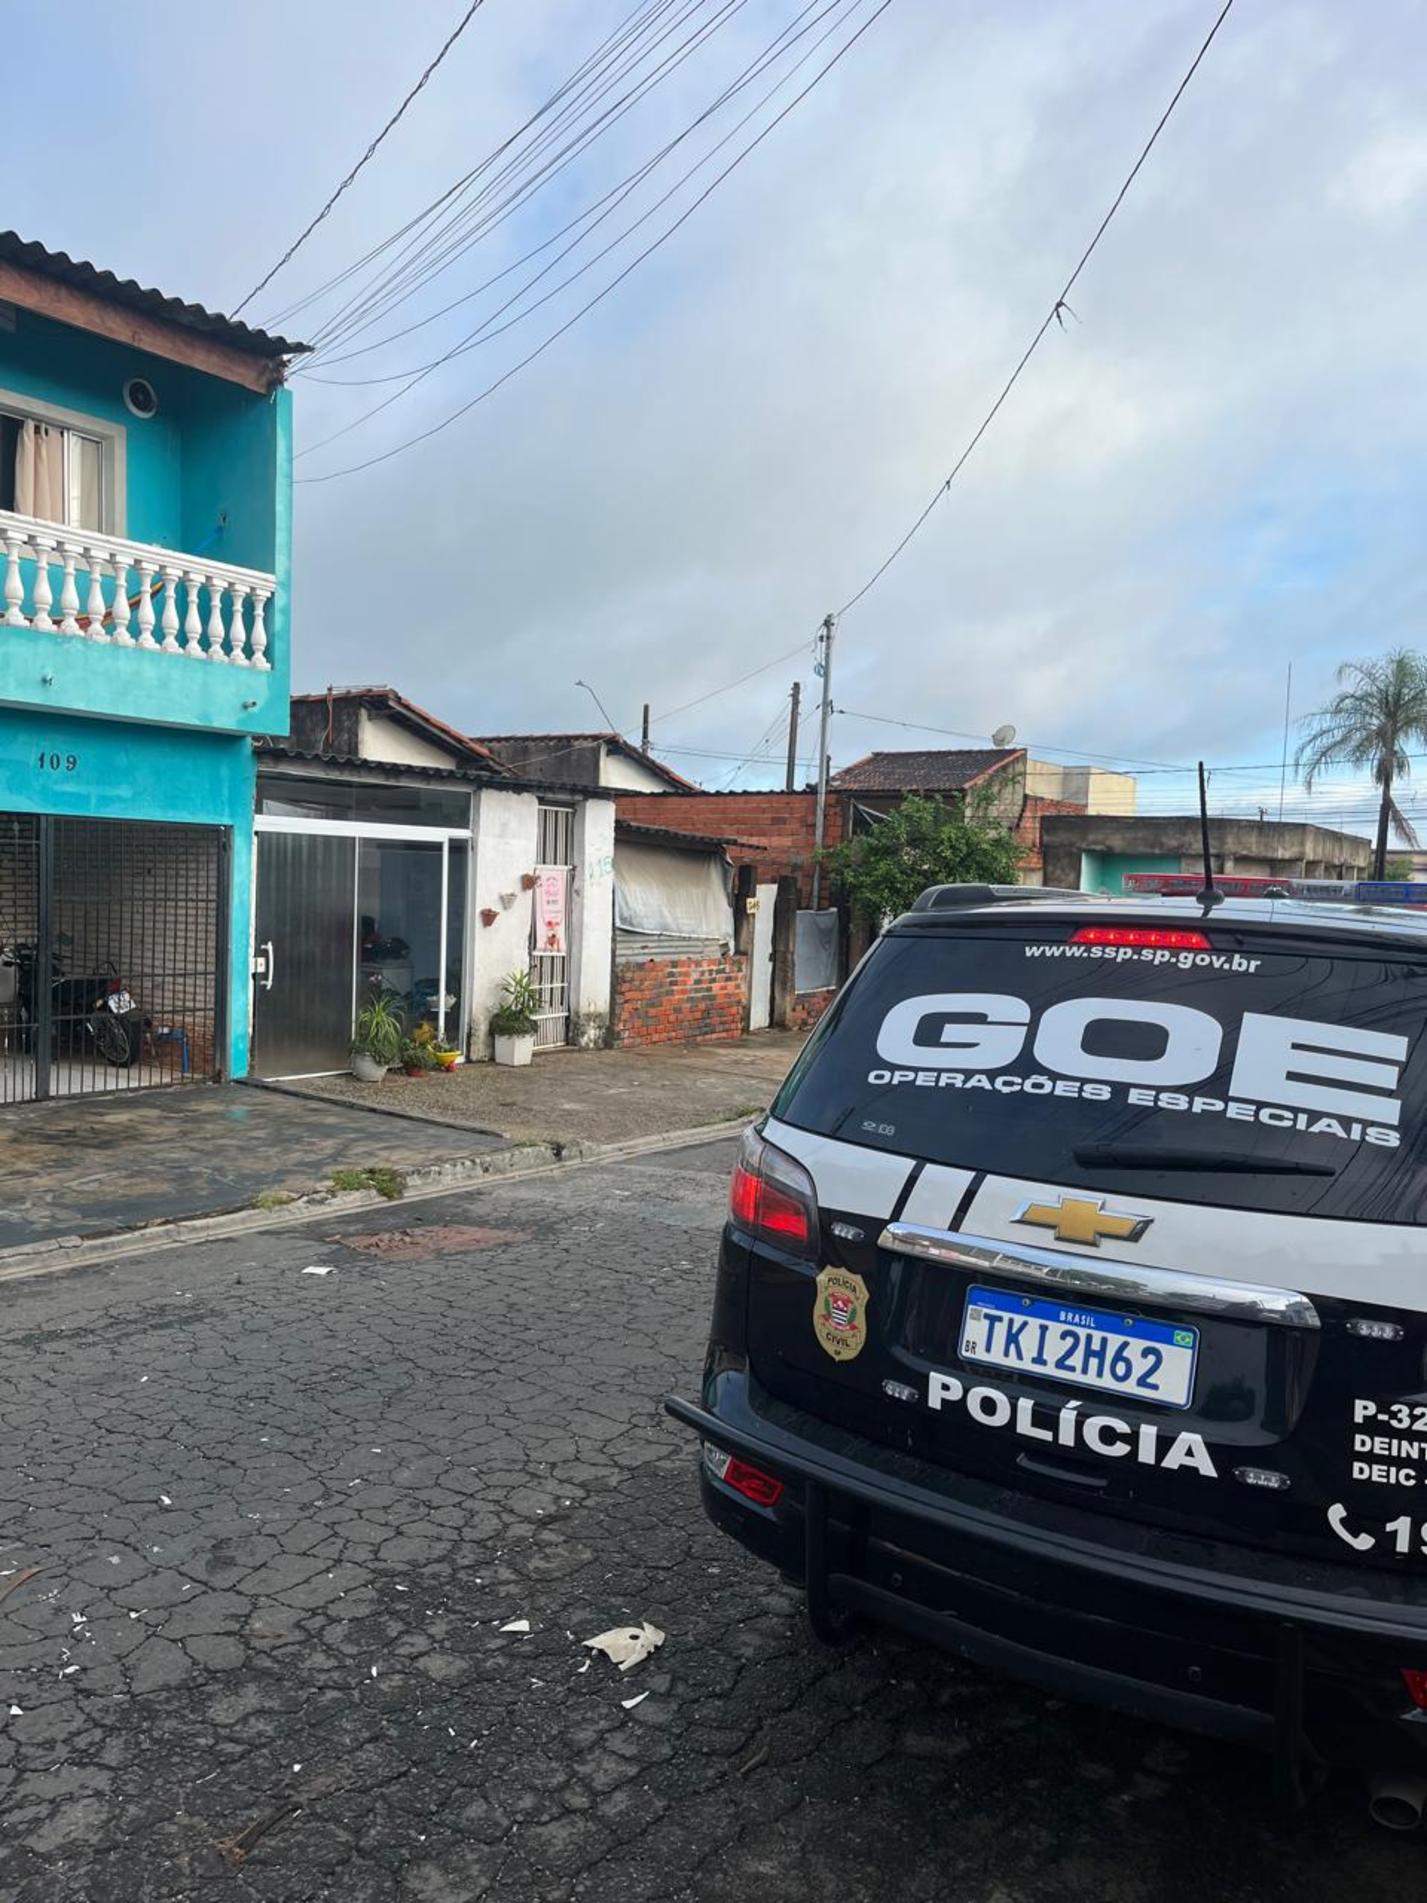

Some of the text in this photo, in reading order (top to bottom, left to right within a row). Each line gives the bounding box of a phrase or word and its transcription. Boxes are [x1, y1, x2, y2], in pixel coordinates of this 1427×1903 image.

[38, 752, 77, 771] 109
[1024, 943, 1261, 973] www.ssp.sp.gov.br
[876, 992, 1409, 1126] GOE
[867, 1068, 1401, 1148] OPERAÇÕES ESPECIAIS
[1059, 1311, 1096, 1328] BRASIL
[825, 1332, 850, 1348] CIVIL
[964, 1340, 977, 1355] BR
[982, 1312, 1163, 1391] TKI2H62
[927, 1371, 1219, 1479] POLÍCIA
[1353, 1399, 1427, 1431] P-32
[1352, 1461, 1417, 1486] DEIC
